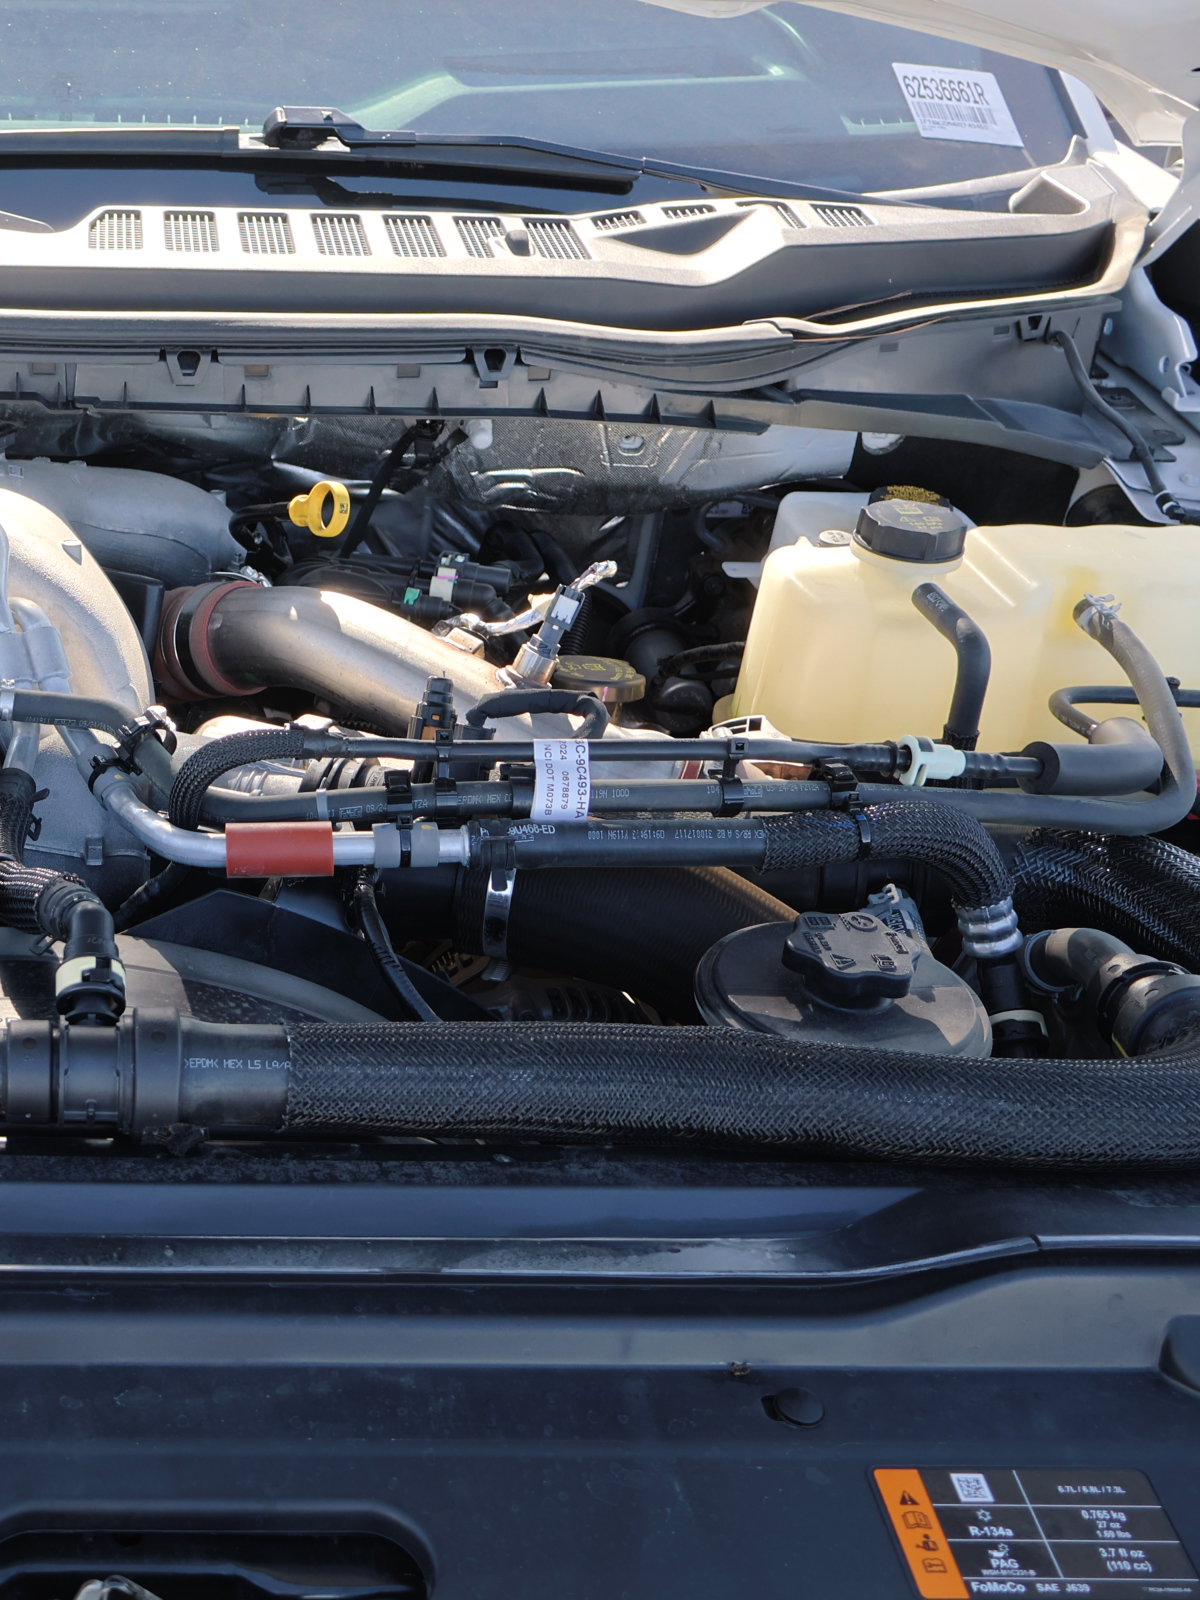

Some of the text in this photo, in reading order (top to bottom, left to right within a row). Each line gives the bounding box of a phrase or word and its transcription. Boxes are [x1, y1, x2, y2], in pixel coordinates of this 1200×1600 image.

[902, 75, 990, 106] 62536661R
[544, 762, 555, 782] DOT
[544, 783, 555, 817] M073B
[1110, 1510, 1127, 1522] kg
[968, 1525, 1014, 1538] R-134a
[1099, 1547, 1116, 1558] 3.7
[1129, 1549, 1146, 1559] oz
[990, 1558, 1020, 1569] PAG
[1106, 1560, 1153, 1573] (110 cc)
[970, 1581, 1091, 1594] FoMoCo SAE J639
